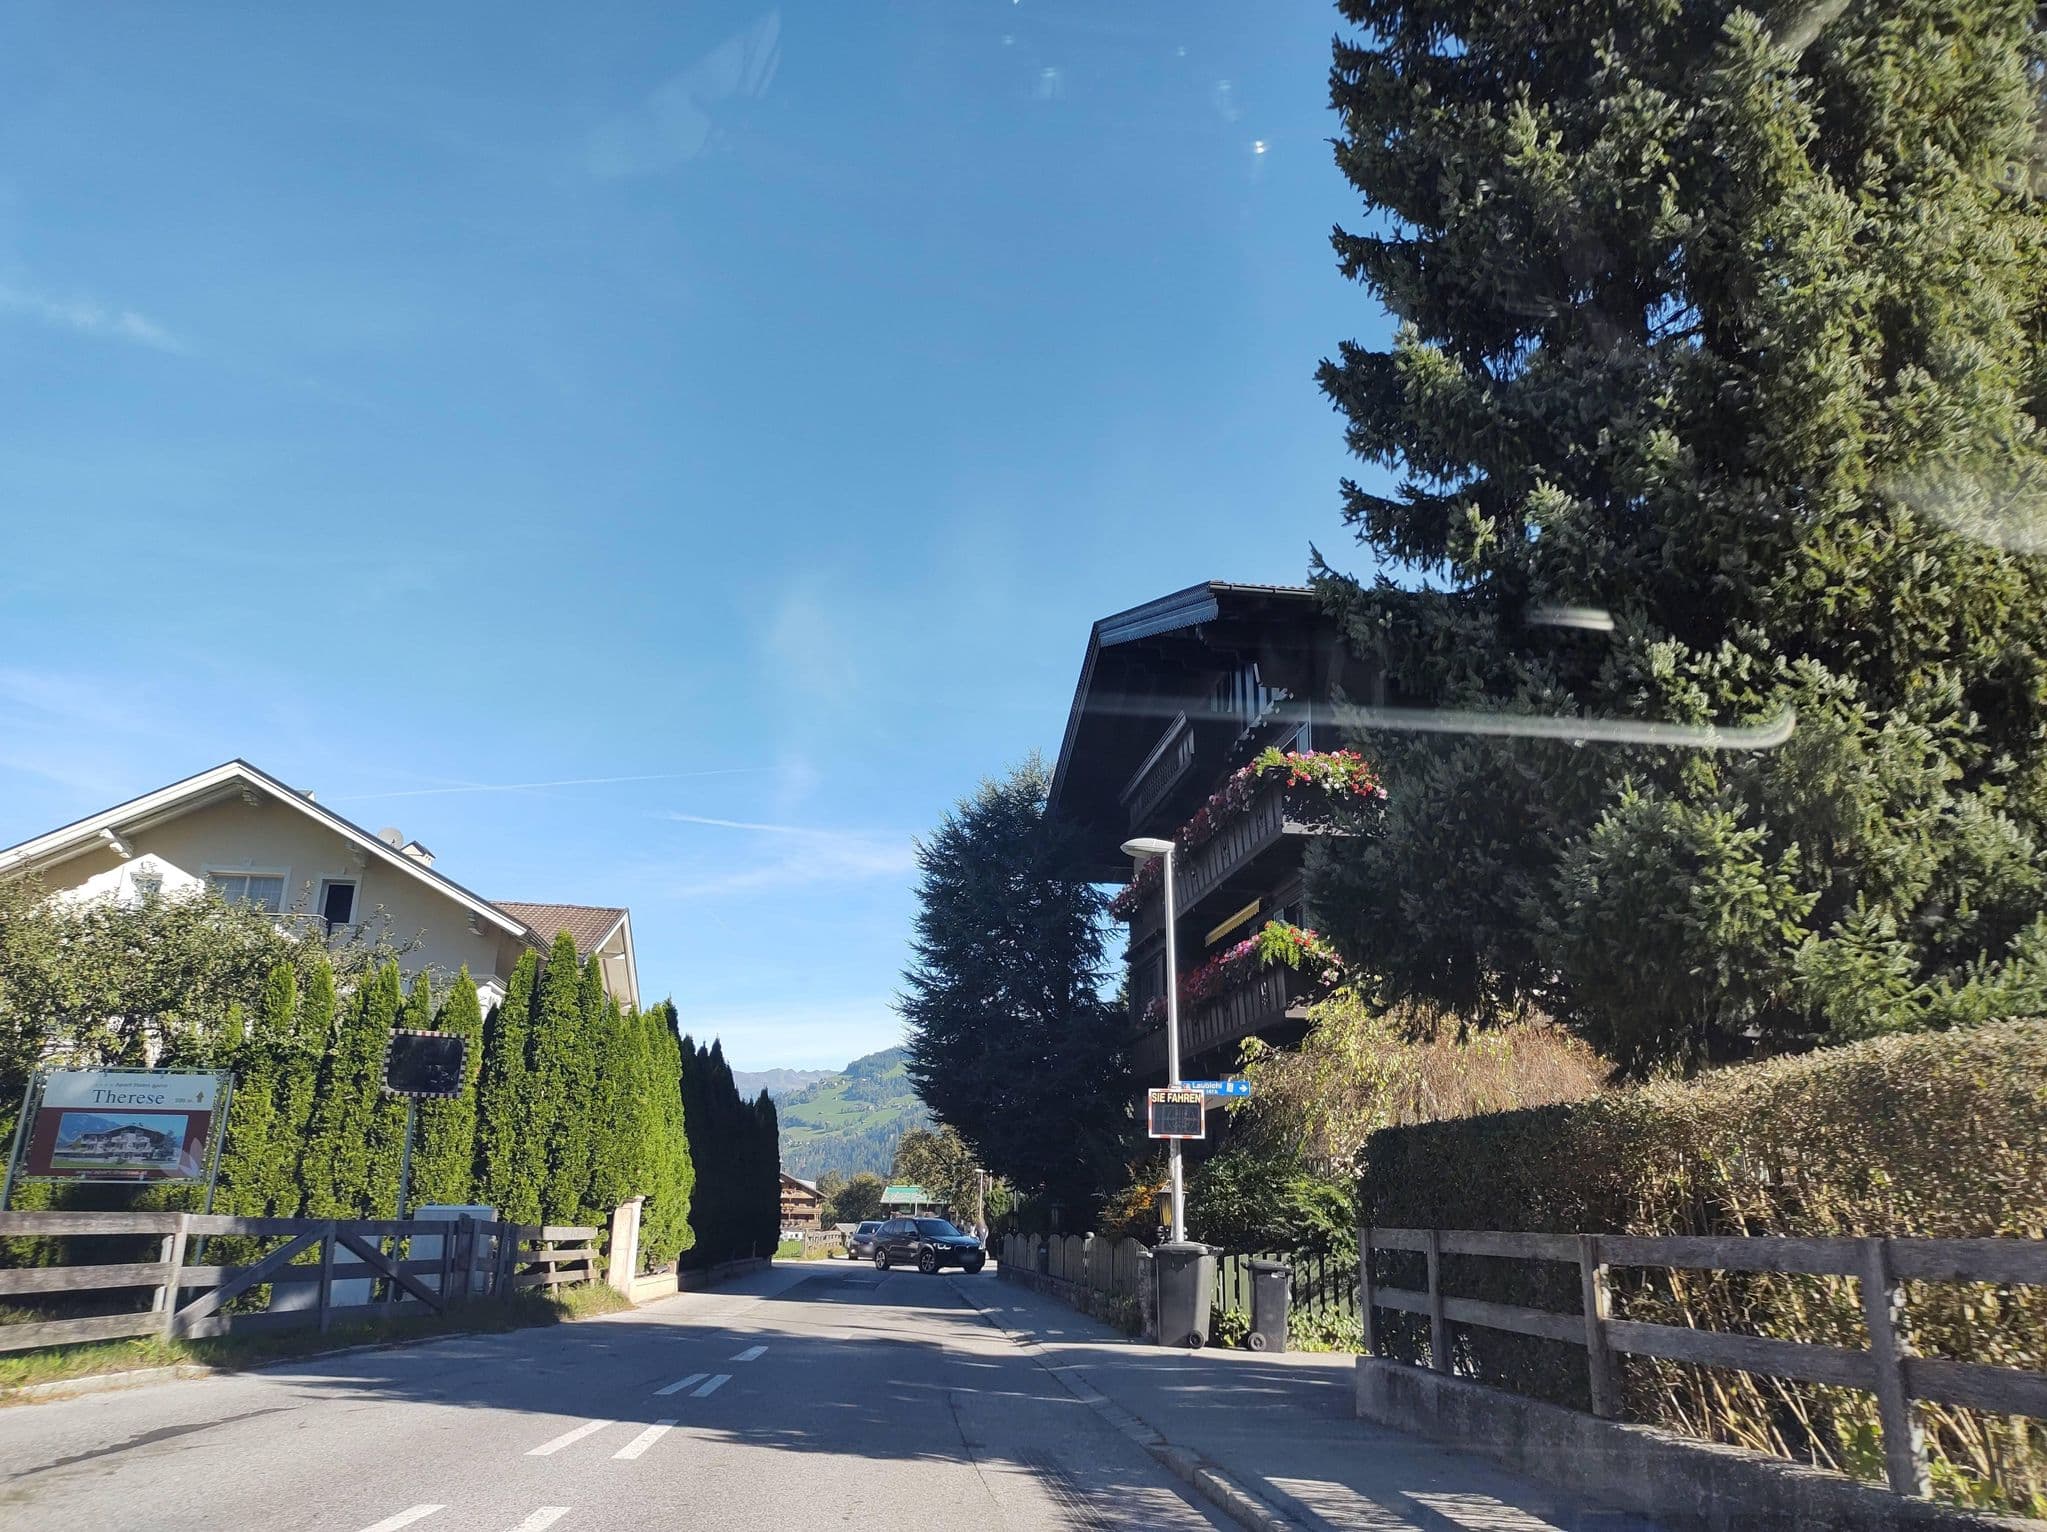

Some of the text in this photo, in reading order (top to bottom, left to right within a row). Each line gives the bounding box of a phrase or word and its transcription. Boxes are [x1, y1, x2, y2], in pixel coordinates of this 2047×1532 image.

[93, 1089, 165, 1105] Therese
[1151, 1092, 1201, 1104] SIE FAHREN
